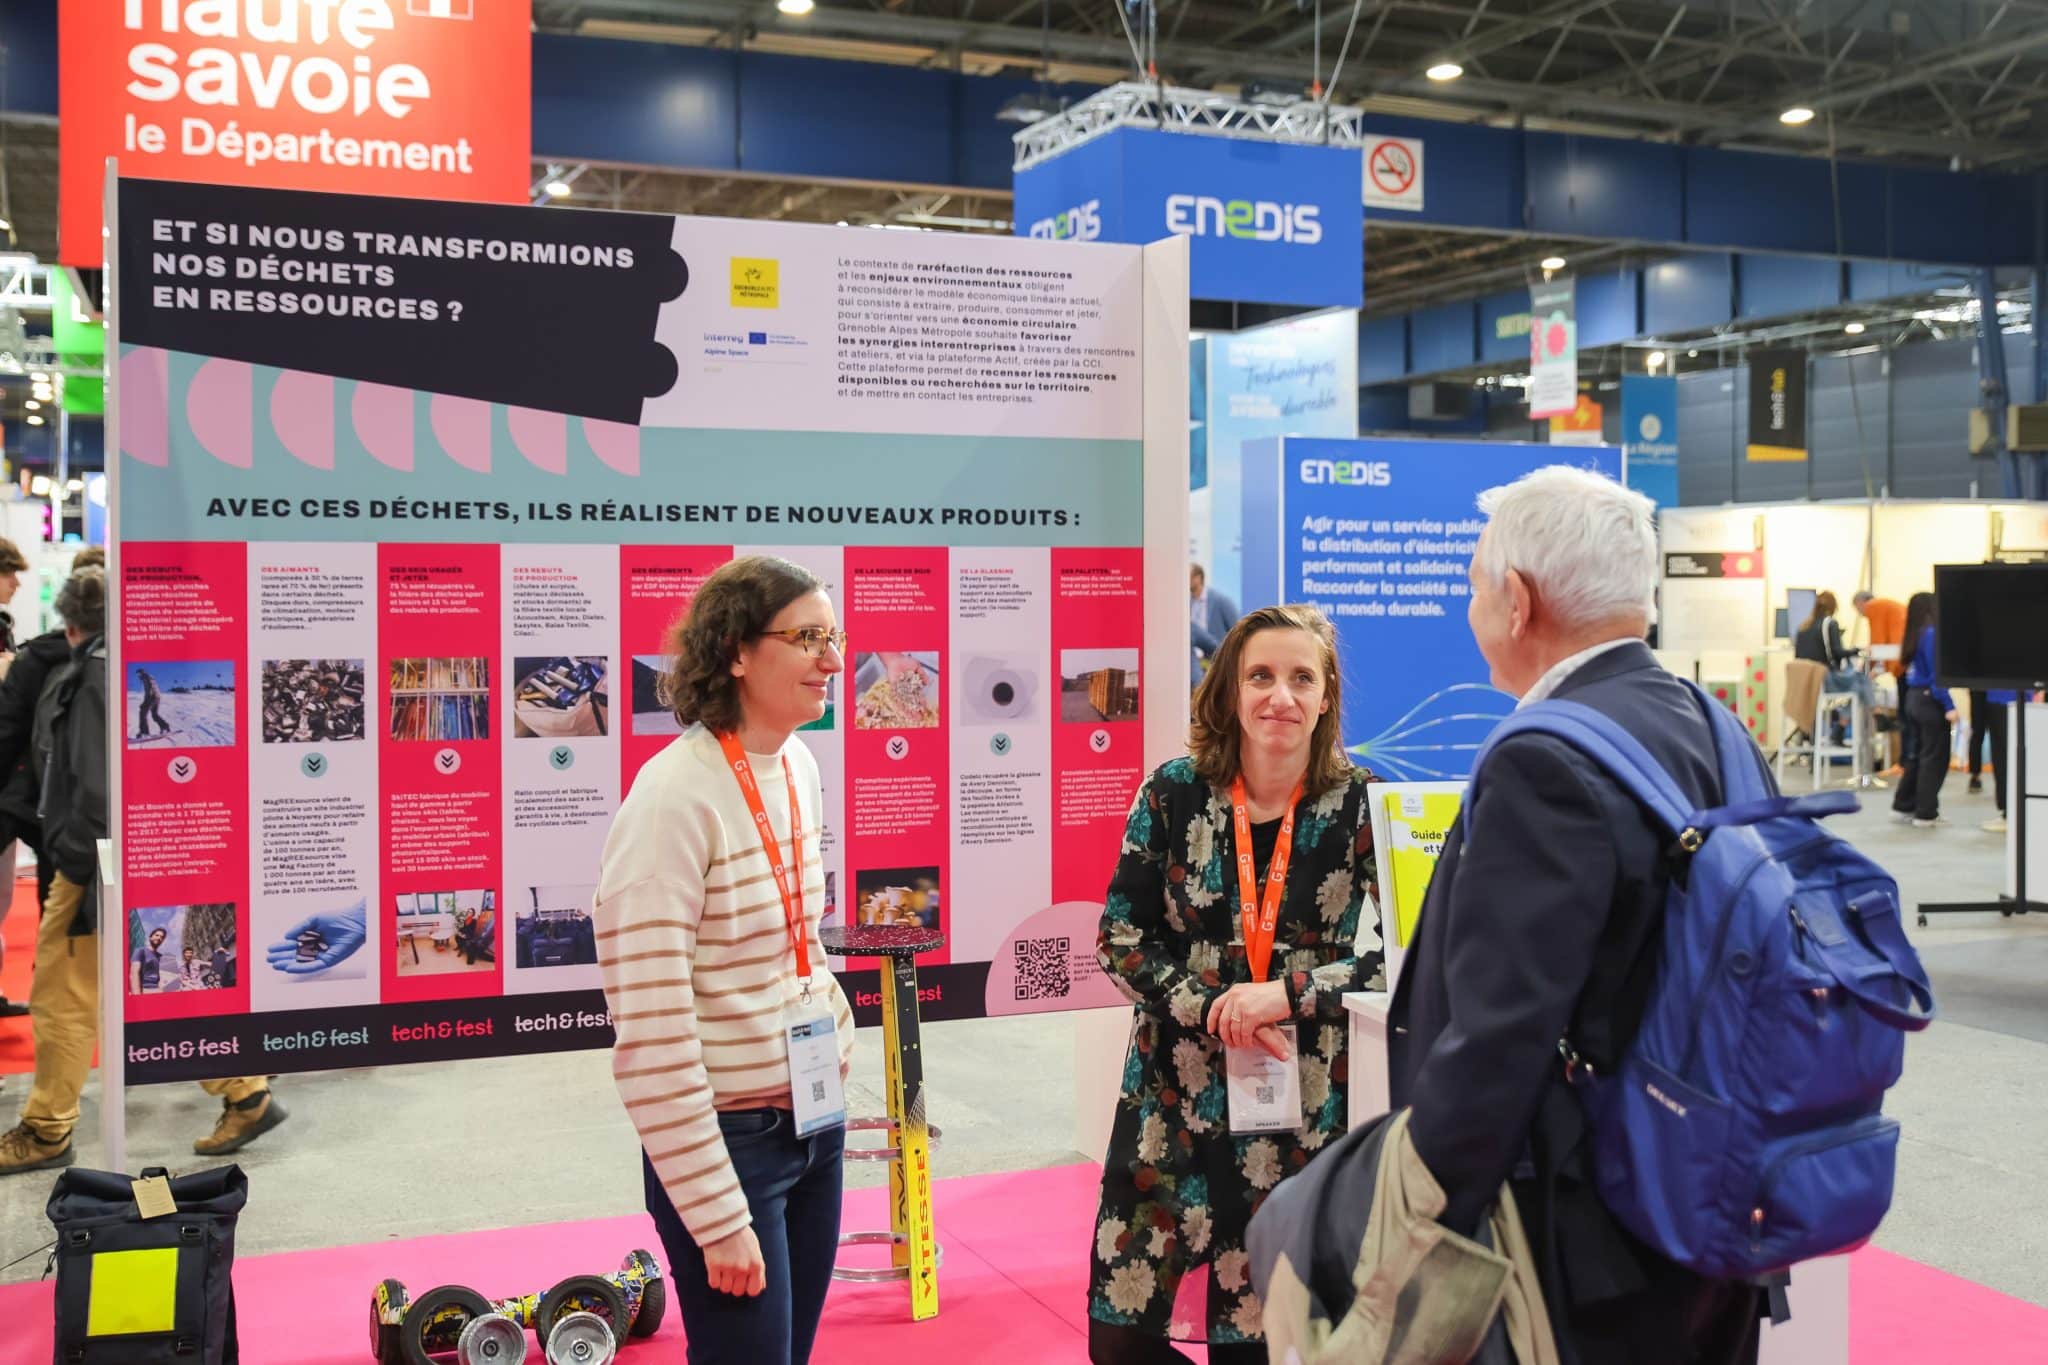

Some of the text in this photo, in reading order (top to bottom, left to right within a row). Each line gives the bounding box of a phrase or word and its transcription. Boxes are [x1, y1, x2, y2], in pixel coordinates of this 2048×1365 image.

[126, 43, 430, 119] savoie
[125, 113, 472, 173] le Département
[153, 219, 634, 268] ET SI NOUS TRANSFORMIONS
[153, 253, 395, 287] NOS DÉCHETS
[838, 258, 1073, 279] Le contexte de raréfaction des ressources
[153, 286, 463, 322] EN RESSOURCES ?
[838, 323, 1071, 341] Grenoble Alpes Métropole souhaite favoriser
[838, 375, 1093, 392] disponibles ou recherchées sur le territoire.
[207, 498, 291, 517] AVEC
[300, 499, 360, 518] CES
[369, 496, 519, 524] DÉCHETS,
[527, 503, 572, 521] ILS
[581, 498, 738, 522] RÉALISENT
[745, 506, 780, 523] DE
[787, 506, 934, 525] NOUVEAUX
[942, 508, 1068, 526] PRODUITS
[1303, 516, 1333, 534] Agir
[1336, 520, 1369, 536] pour
[1372, 521, 1390, 532] un
[1393, 519, 1443, 533] service
[1302, 537, 1477, 554] la distribution d'électricit
[1303, 558, 1466, 576] performant et solidaire.
[1303, 579, 1467, 595] Raccorder la société au
[1337, 601, 1384, 616] monde
[1387, 601, 1445, 616] durable.
[1411, 830, 1442, 840] Guide
[1423, 845, 1434, 853] et
